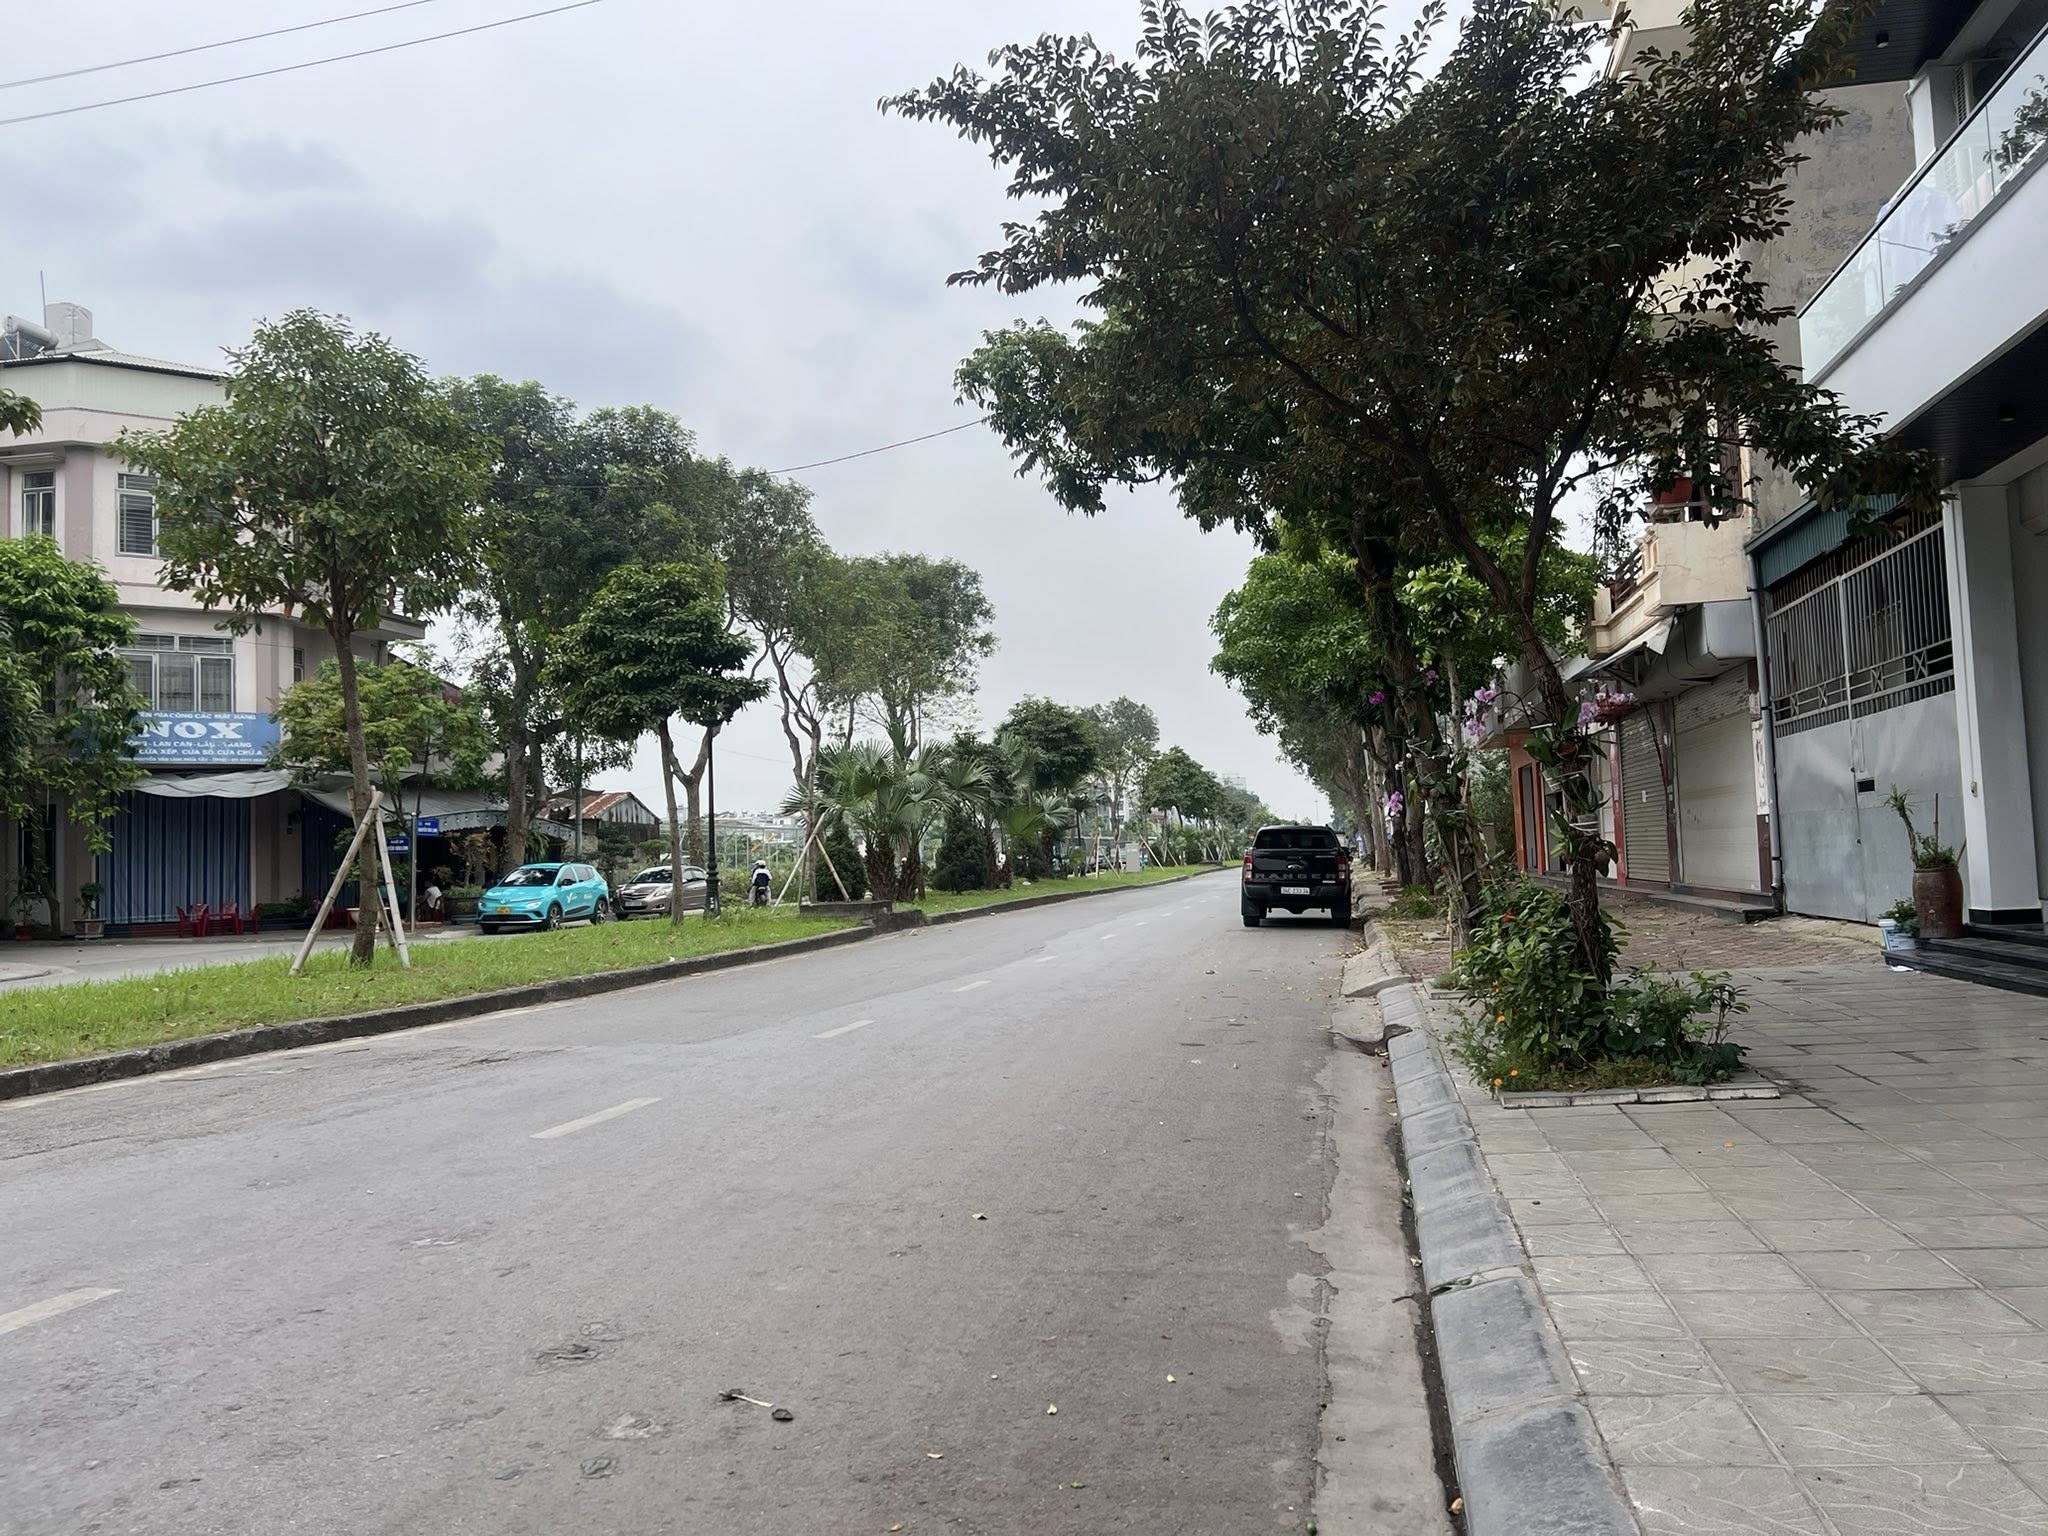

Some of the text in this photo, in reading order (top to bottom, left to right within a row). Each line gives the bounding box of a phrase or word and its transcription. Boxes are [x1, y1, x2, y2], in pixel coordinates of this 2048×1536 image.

[194, 711, 212, 719] CÁC
[138, 721, 243, 739] NOX
[173, 740, 193, 748] CAN
